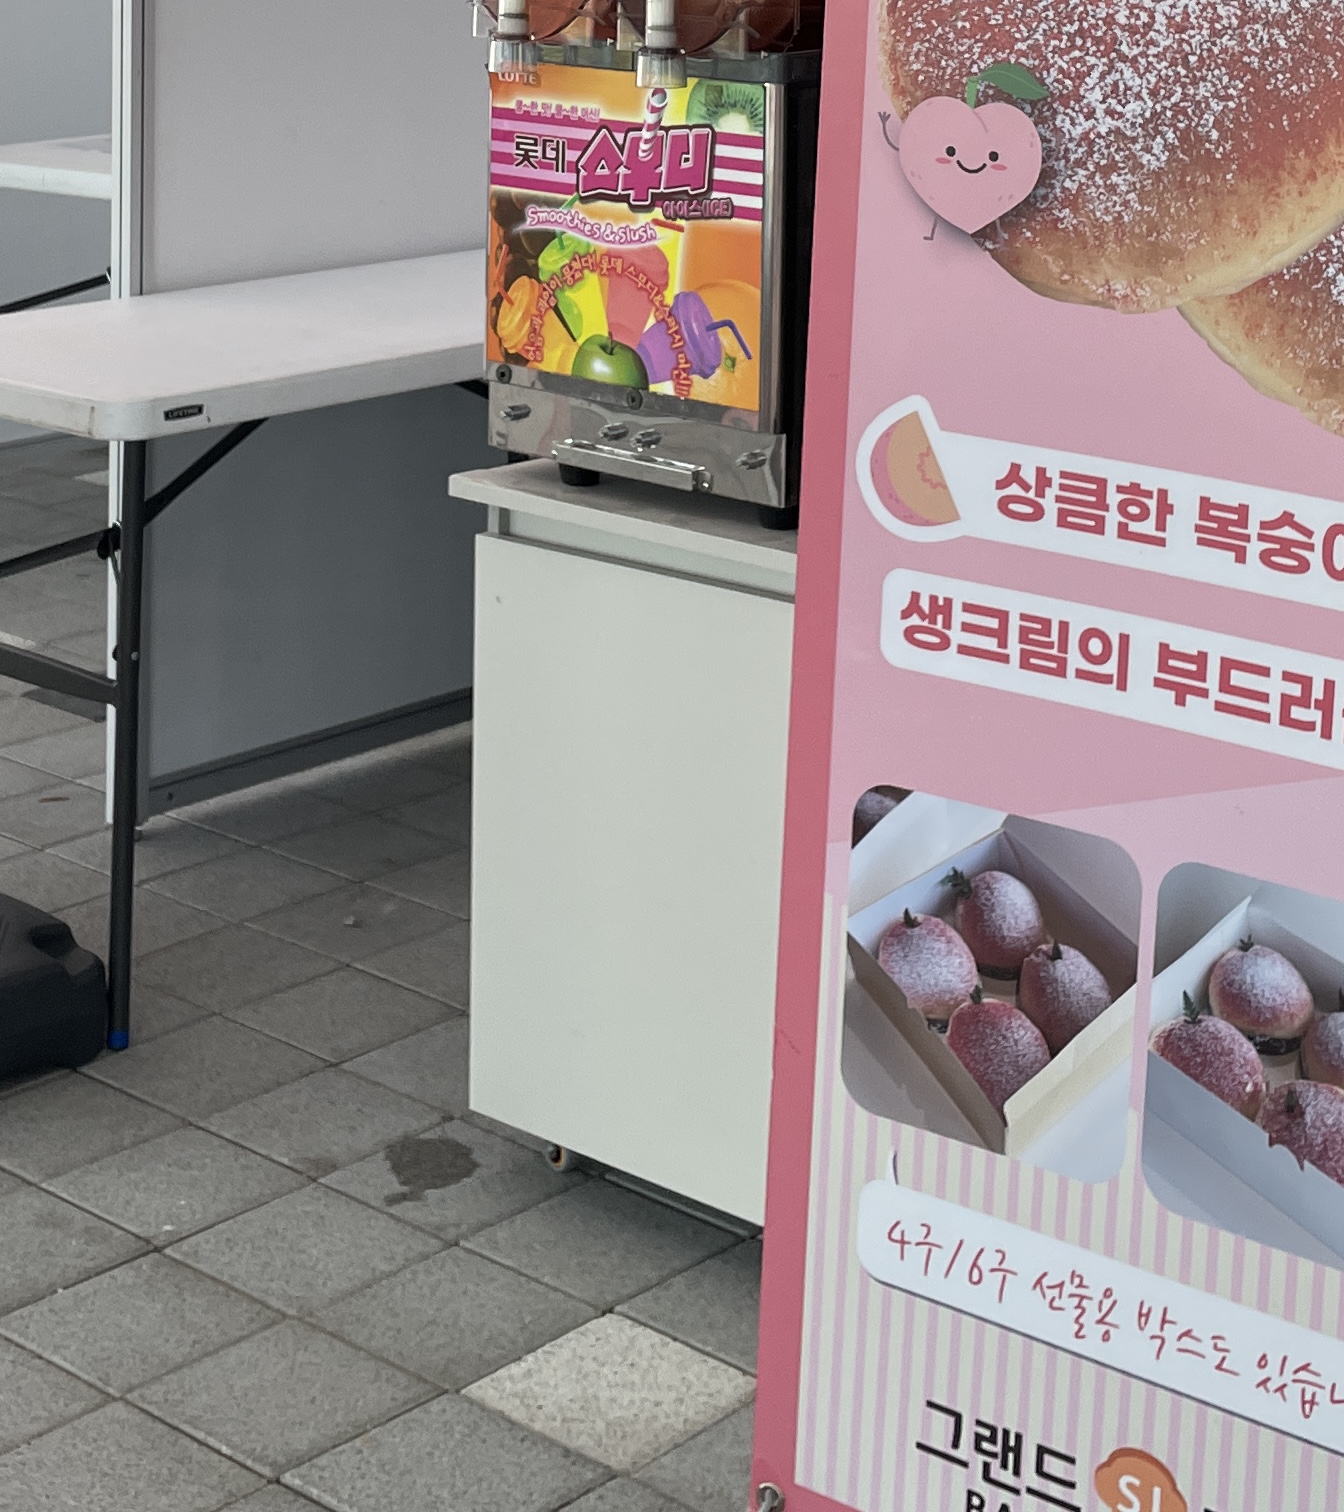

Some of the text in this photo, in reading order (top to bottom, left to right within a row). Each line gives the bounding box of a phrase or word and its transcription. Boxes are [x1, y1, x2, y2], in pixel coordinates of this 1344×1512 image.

[514, 134, 566, 173] 롯데
[527, 208, 601, 237] Smoothies
[994, 462, 1176, 548] 상큼한
[900, 588, 1130, 694] 생크림의
[885, 1219, 1020, 1304] 4구/6구
[1032, 1269, 1121, 1343] 선물용
[1136, 1304, 1241, 1378] 박스도
[916, 1399, 1082, 1512] 그랜드
